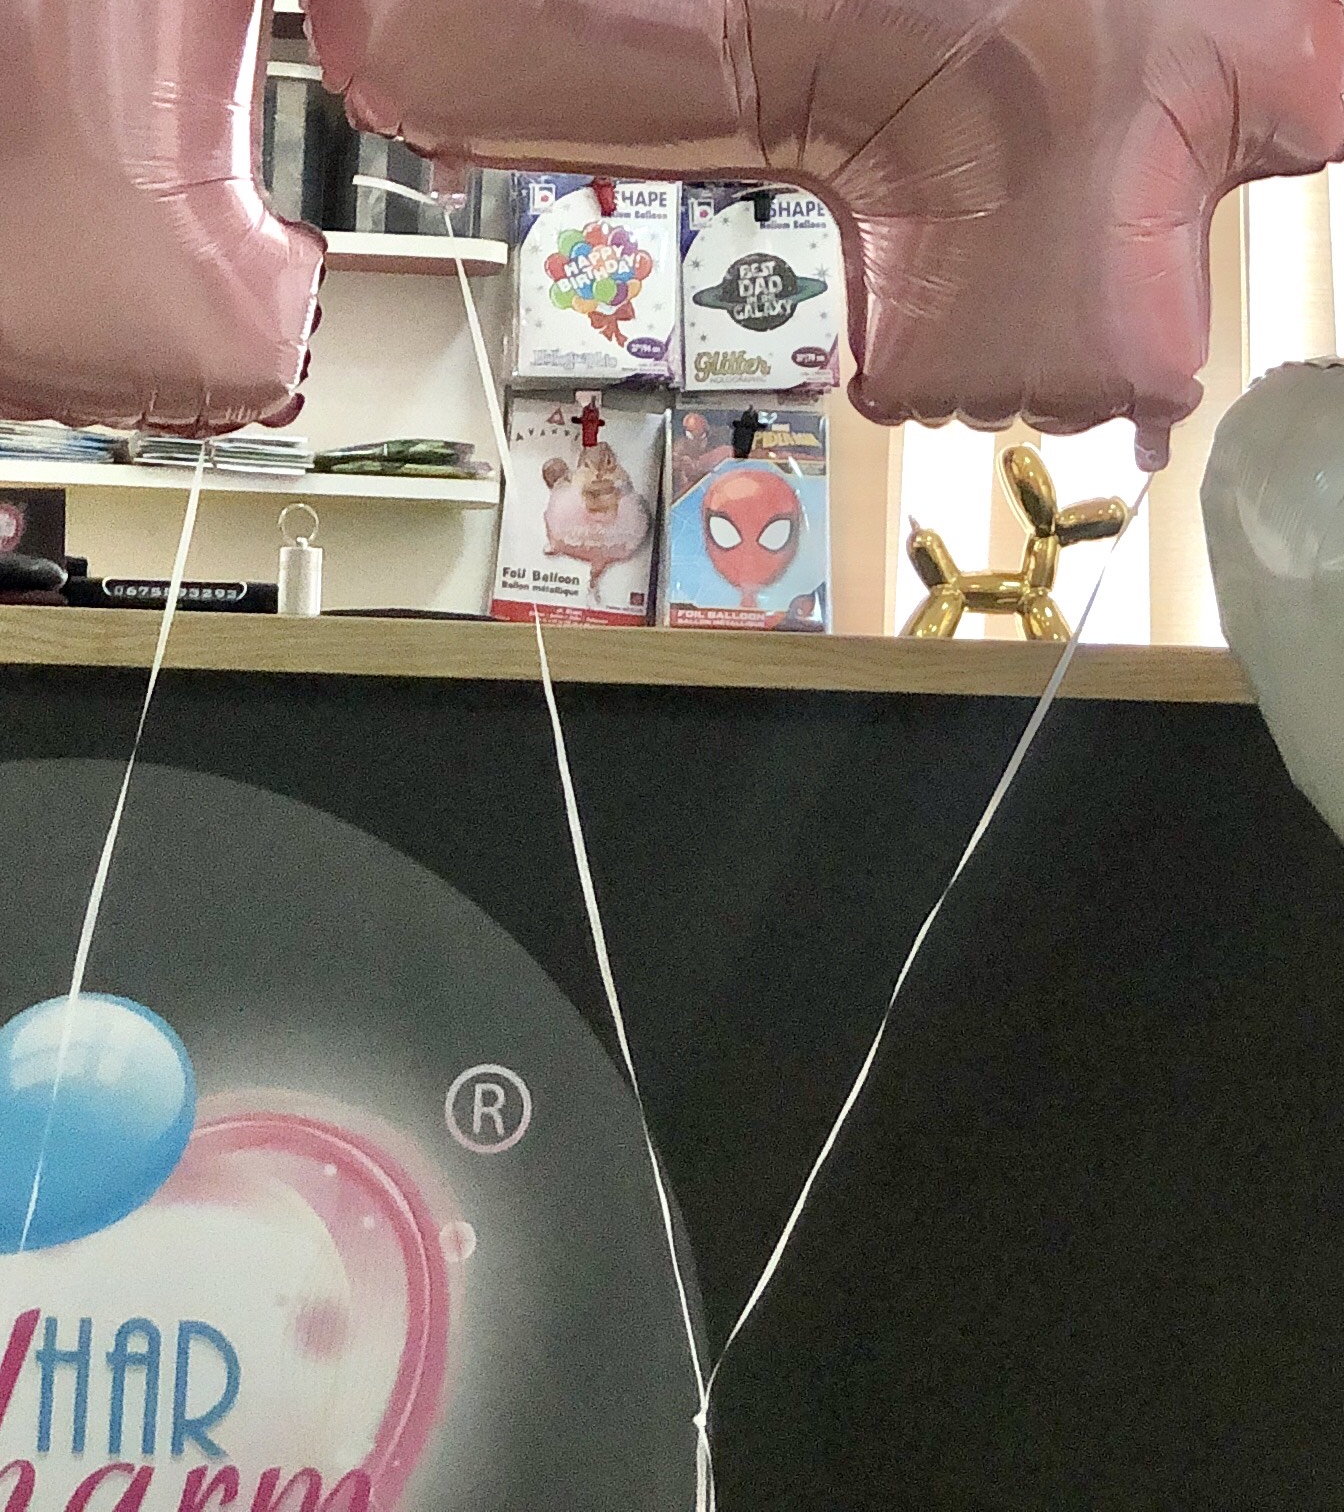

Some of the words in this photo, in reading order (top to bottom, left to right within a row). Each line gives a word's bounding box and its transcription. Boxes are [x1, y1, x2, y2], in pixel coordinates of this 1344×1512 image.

[615, 190, 667, 208] HAPE
[557, 253, 642, 292] BIRTHDAY!
[564, 245, 624, 278] HAPPY
[739, 260, 776, 280] BEST
[737, 274, 783, 298] DAD
[733, 299, 793, 321] GALAXY
[694, 349, 772, 383] Glitter
[532, 570, 581, 586] Balloon
[677, 609, 705, 619] FOIL
[707, 610, 766, 621] BALLOON
